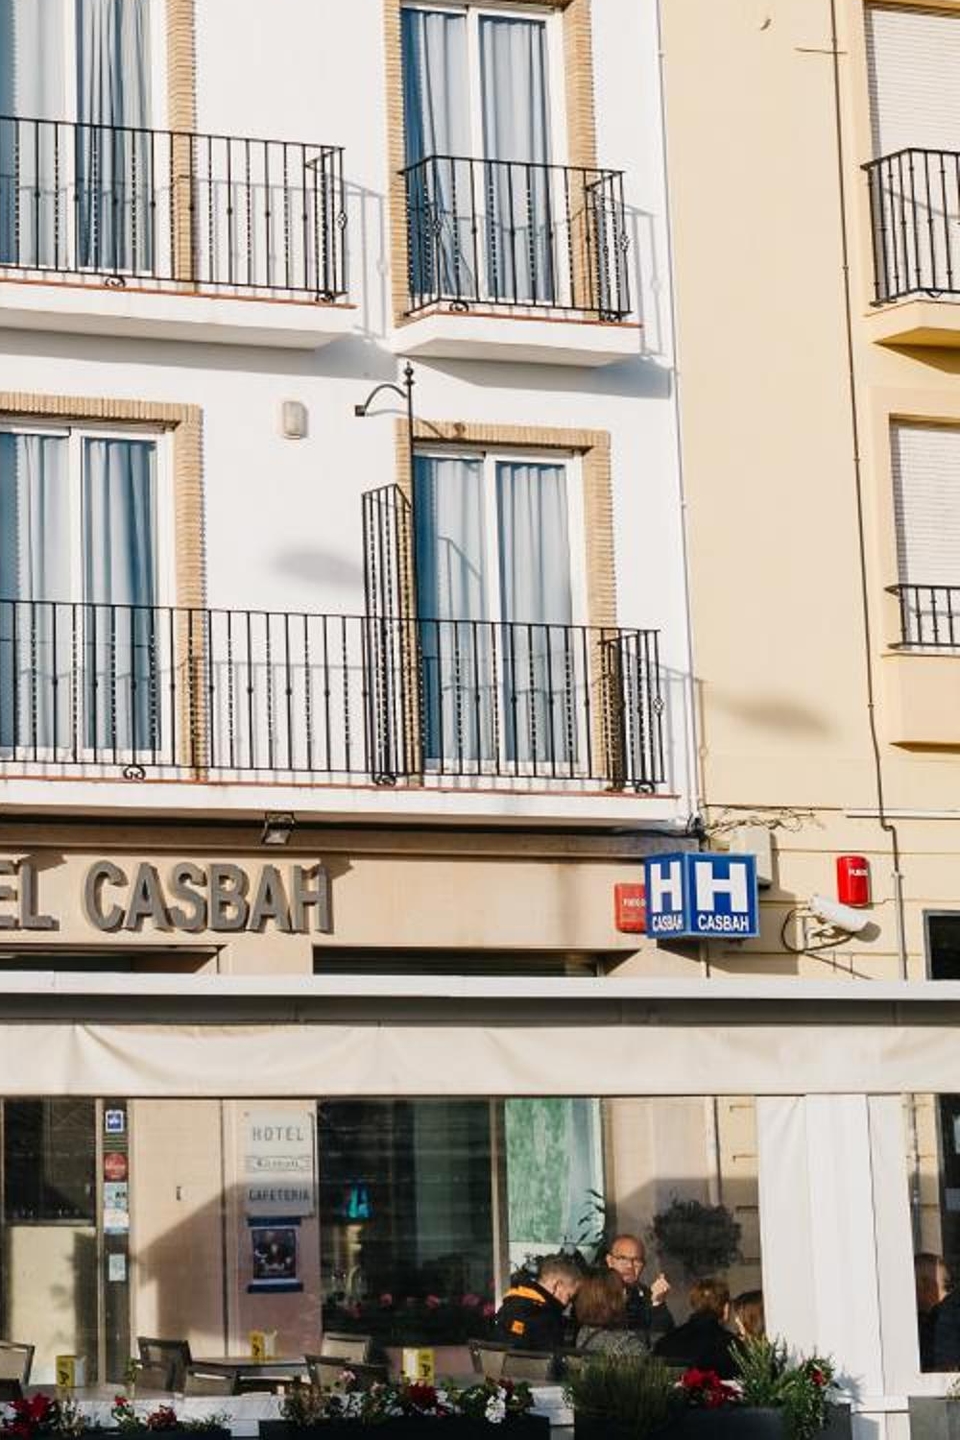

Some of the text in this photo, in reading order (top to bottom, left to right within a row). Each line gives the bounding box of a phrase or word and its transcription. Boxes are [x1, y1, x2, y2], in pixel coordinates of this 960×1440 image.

[83, 860, 333, 934] CASBAH
[649, 861, 683, 913] H
[695, 862, 749, 912] H
[652, 913, 684, 932] CASBAH
[698, 914, 750, 932] CASBAH
[252, 1125, 304, 1141] HOTEL
